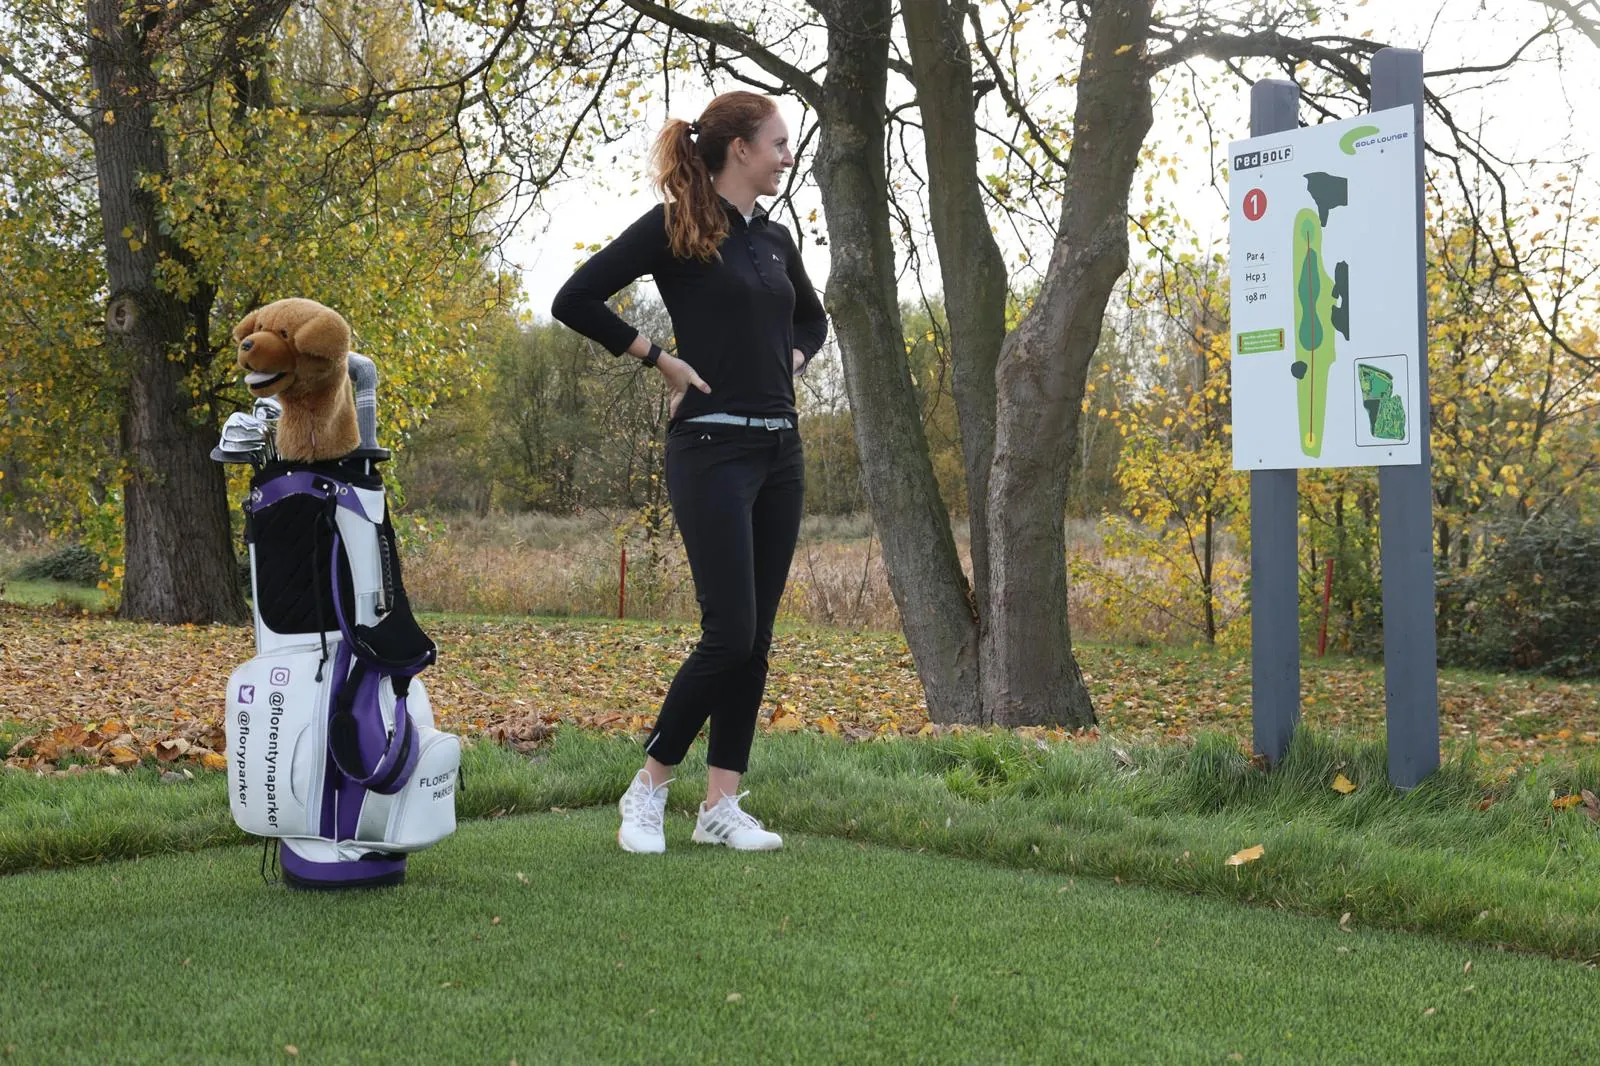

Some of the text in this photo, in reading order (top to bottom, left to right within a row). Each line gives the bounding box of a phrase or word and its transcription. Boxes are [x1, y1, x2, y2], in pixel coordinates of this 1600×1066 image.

[1250, 193, 1259, 217] 1
[1246, 252, 1265, 262] Par 4
[1245, 273, 1267, 283] Hcp 3
[1245, 292, 1267, 304] 198 m
[237, 711, 250, 808] @floryparker
[265, 691, 284, 828] @florentynaparker
